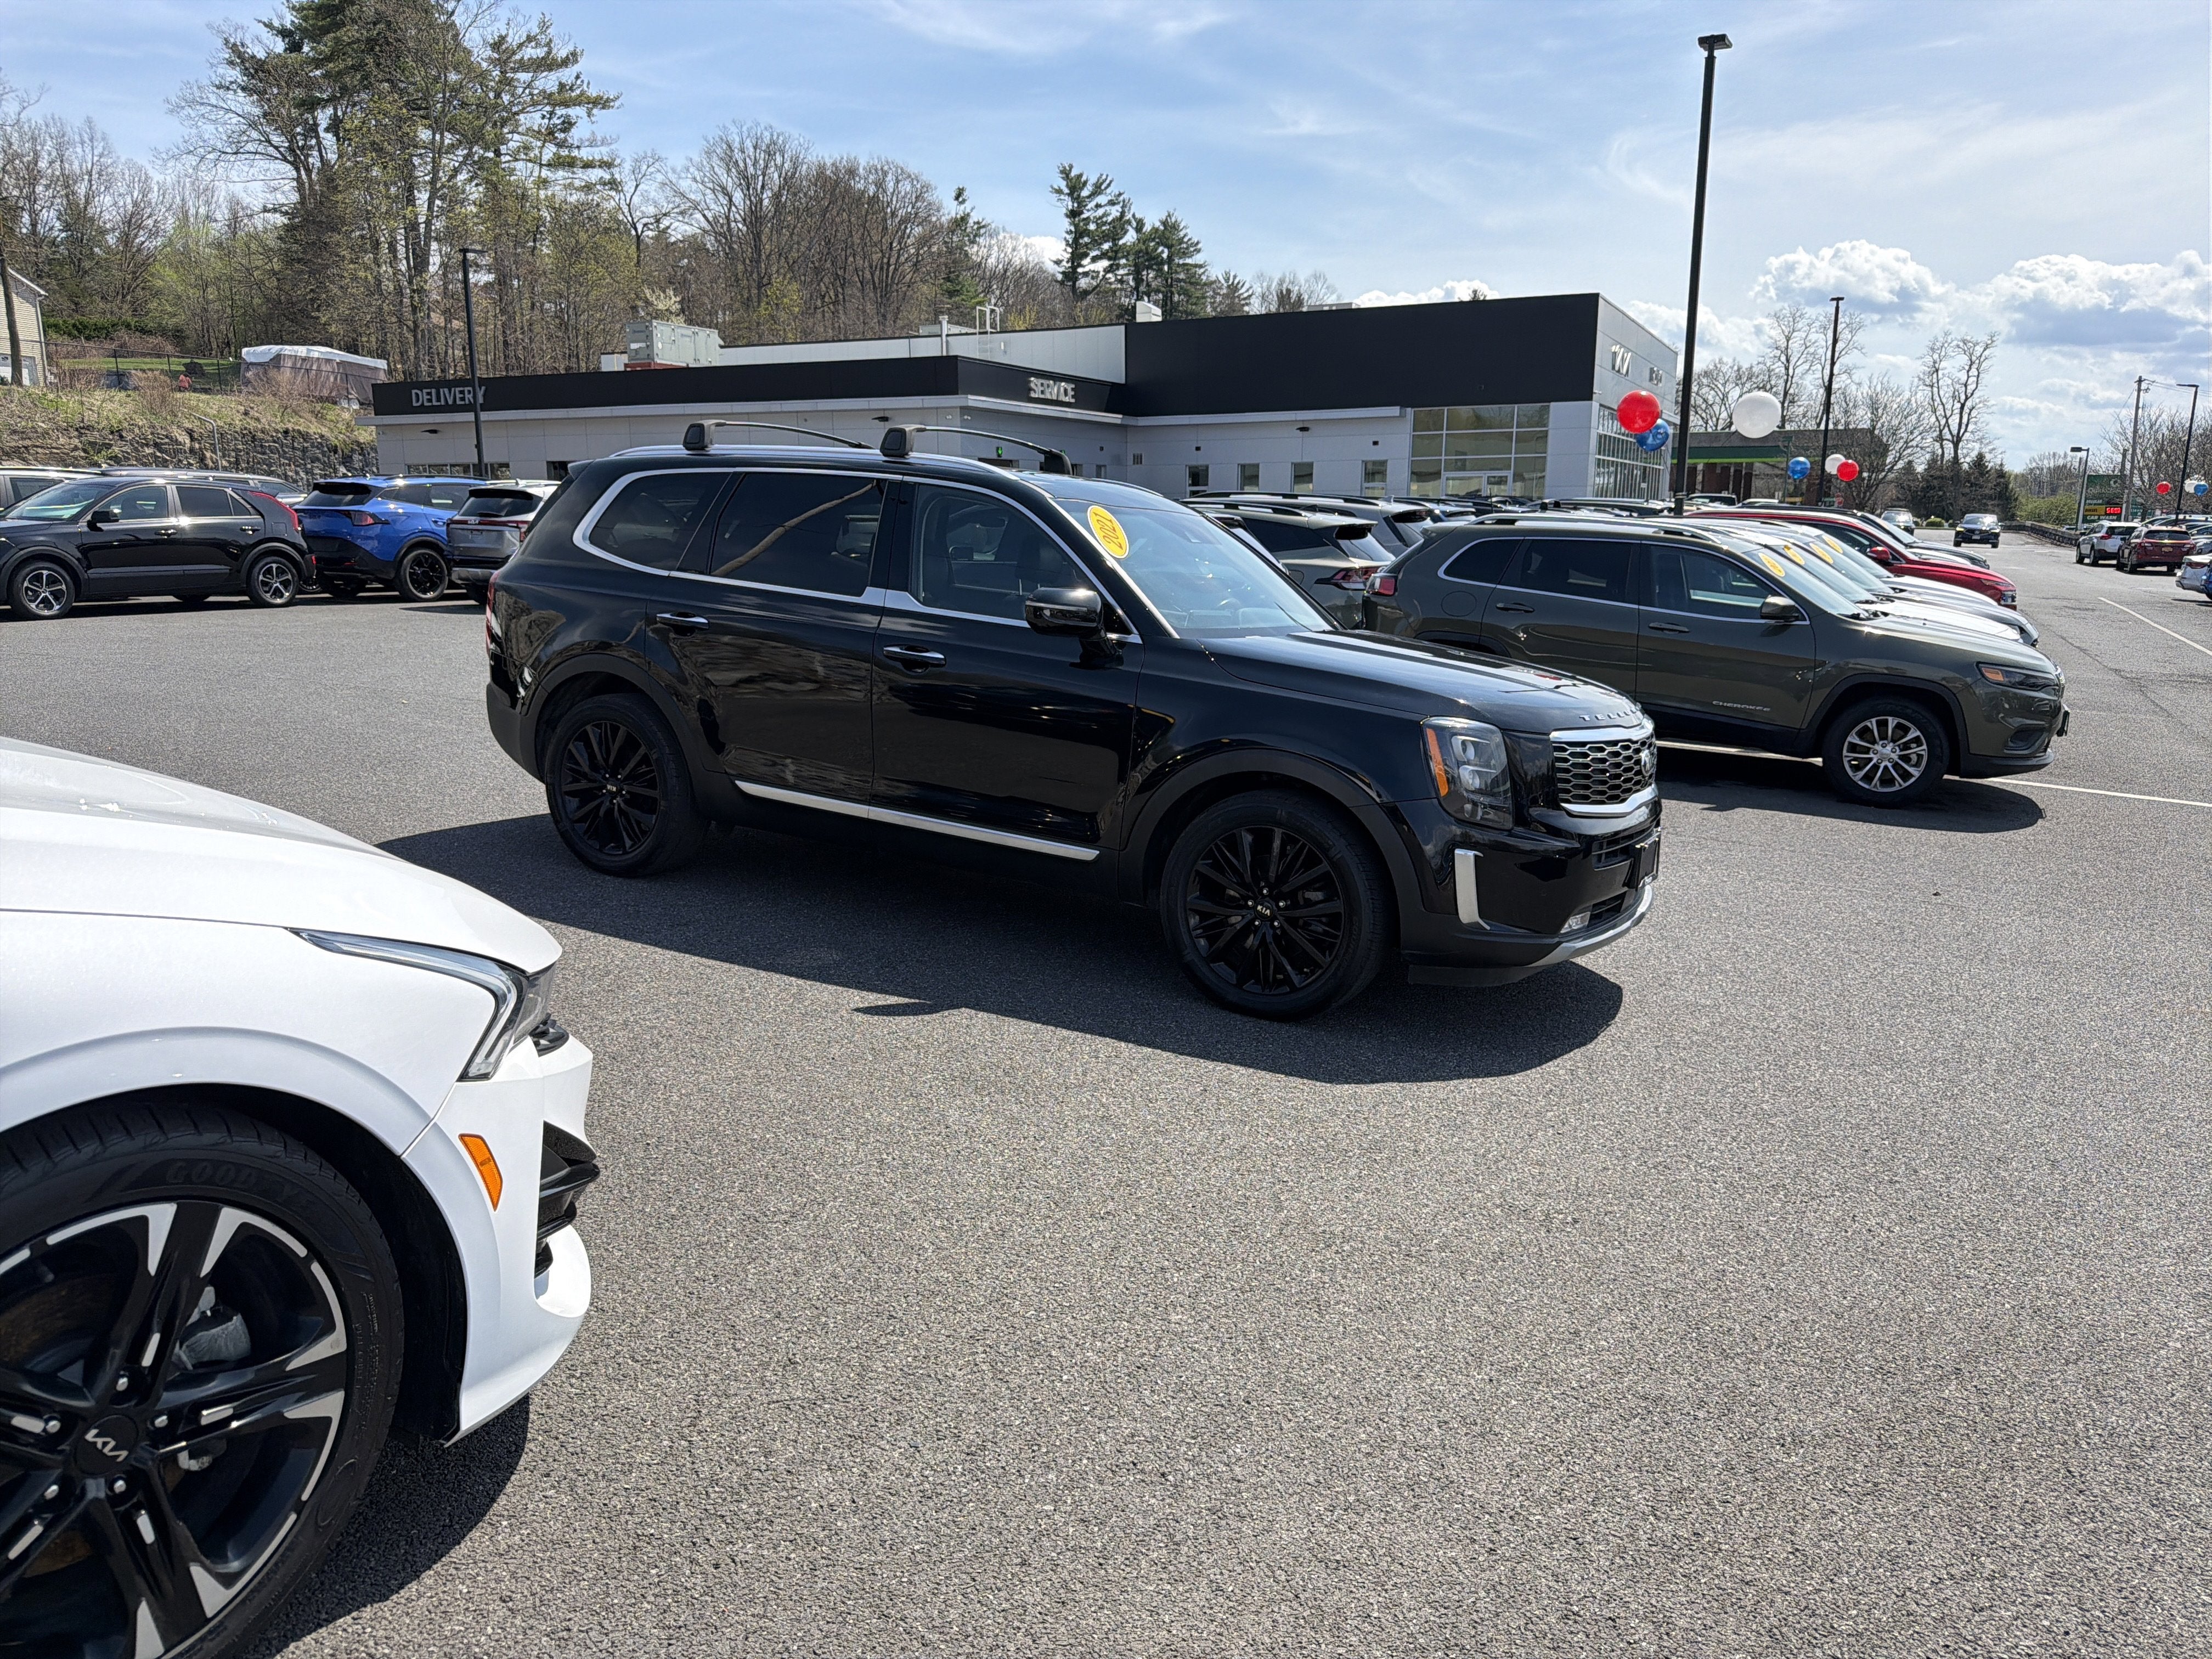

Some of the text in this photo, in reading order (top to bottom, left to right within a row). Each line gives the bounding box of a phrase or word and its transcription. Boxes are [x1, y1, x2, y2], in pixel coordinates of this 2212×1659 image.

[411, 386, 486, 407] DELIVERY
[1029, 377, 1075, 403] SERVICE
[1093, 512, 1124, 550] 2021
[1712, 700, 1771, 712] CHEROKEE
[1257, 905, 1270, 916] KIA
[84, 1429, 129, 1462] KIA
